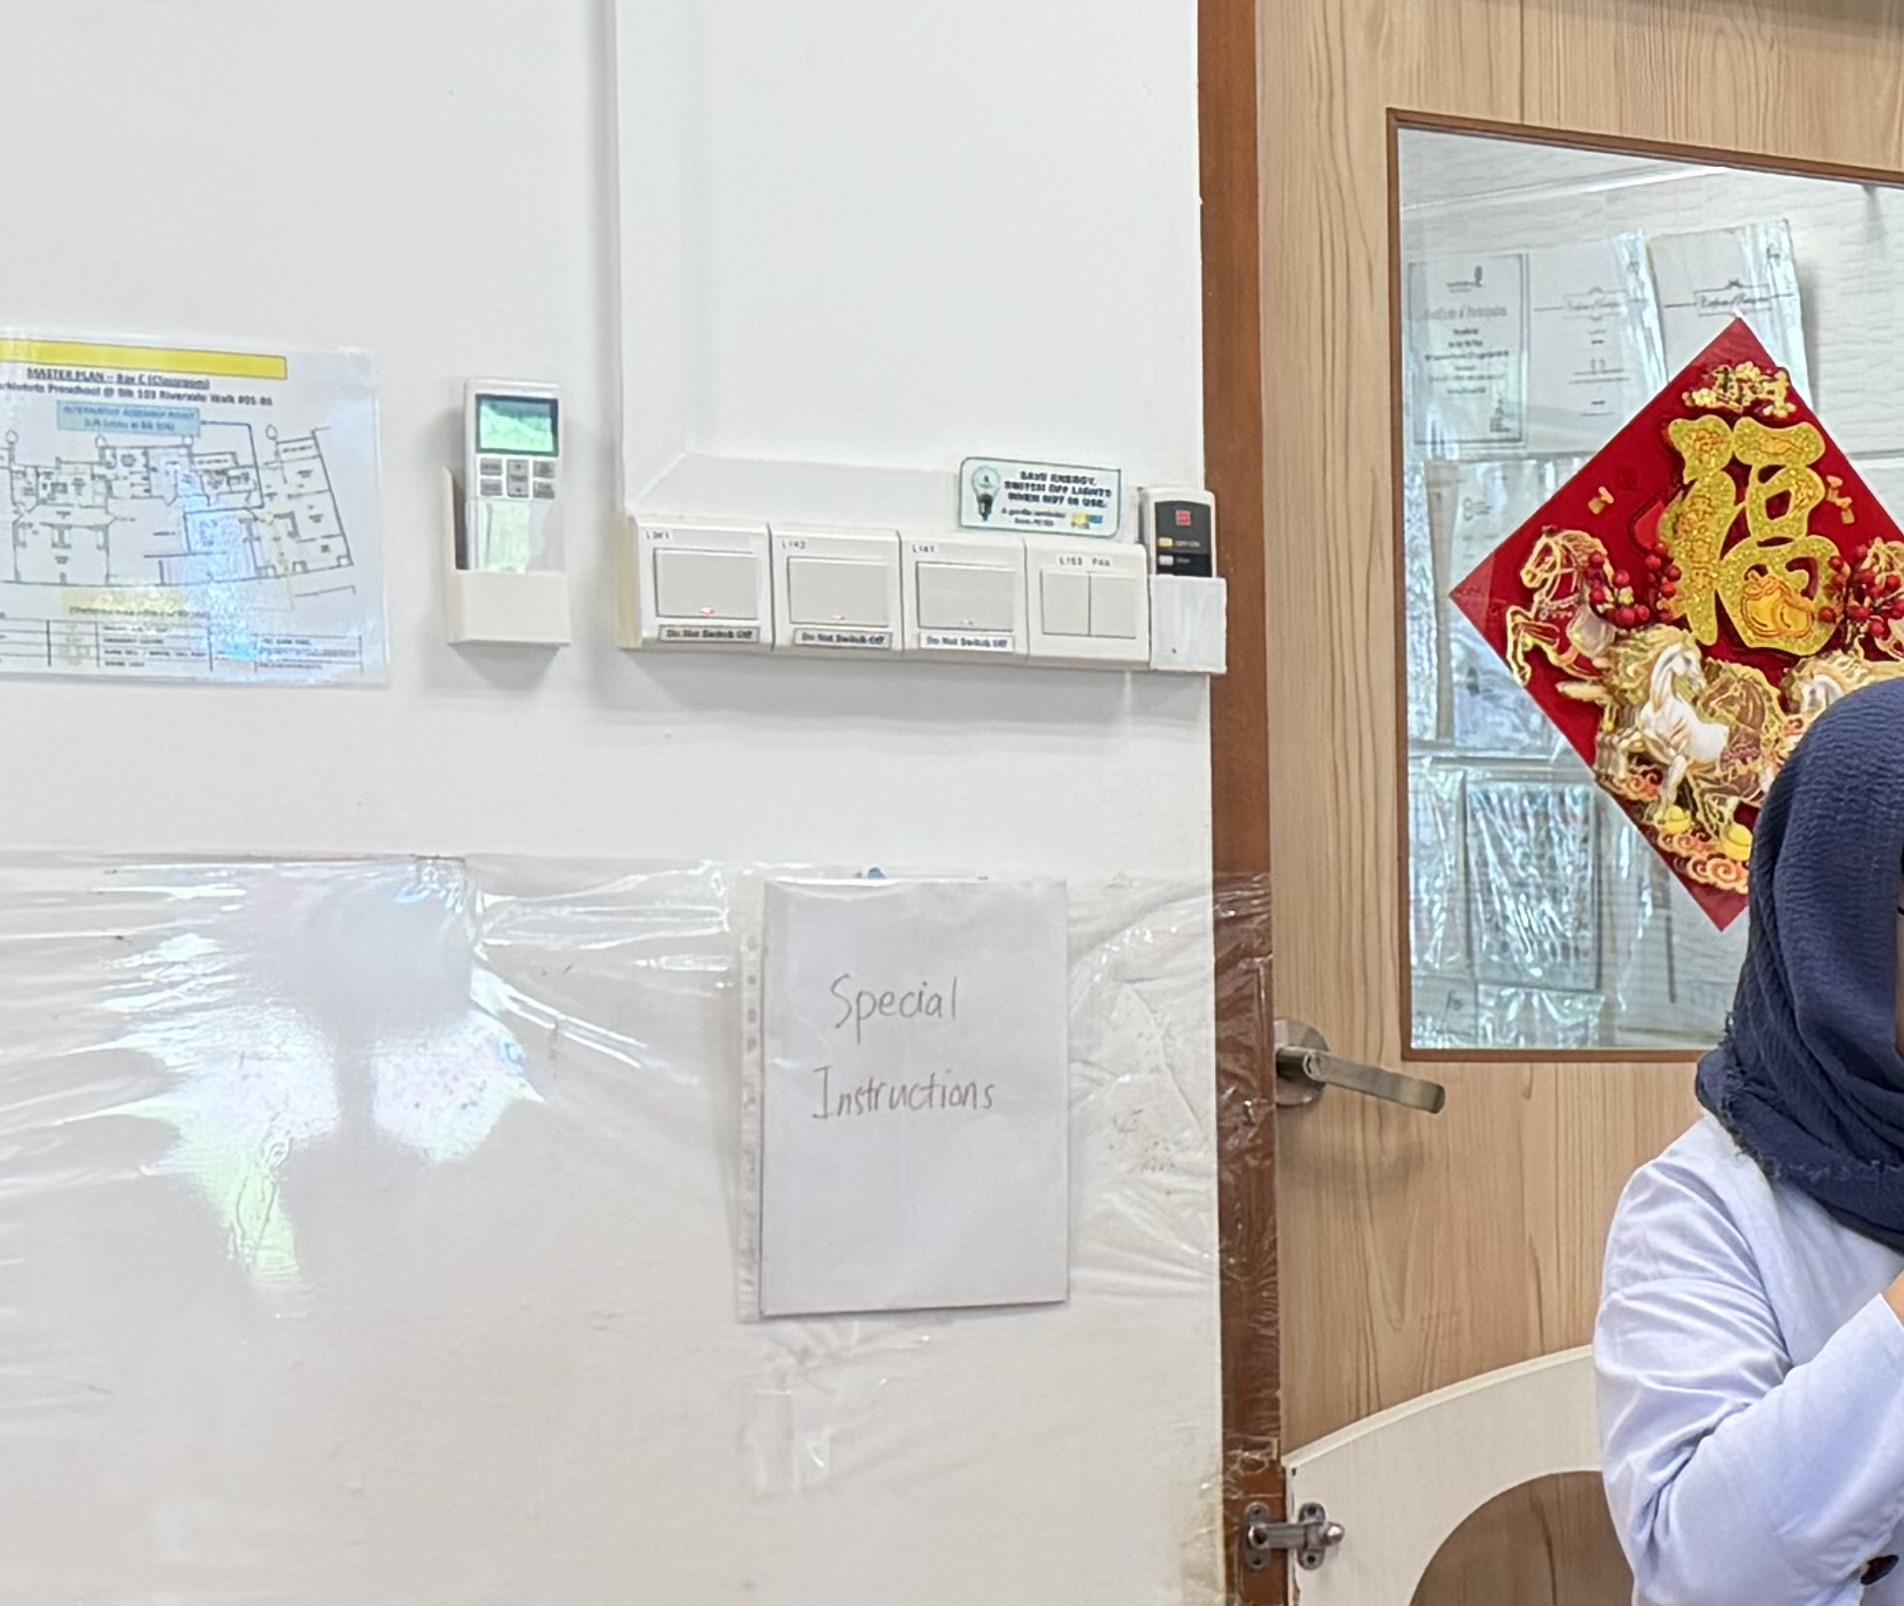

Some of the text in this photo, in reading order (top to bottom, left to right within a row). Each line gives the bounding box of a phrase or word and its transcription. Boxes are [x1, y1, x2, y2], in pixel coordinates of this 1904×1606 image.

[1656, 414, 1842, 656] 福
[830, 973, 959, 1045] Special
[811, 1065, 996, 1121] Instructions
